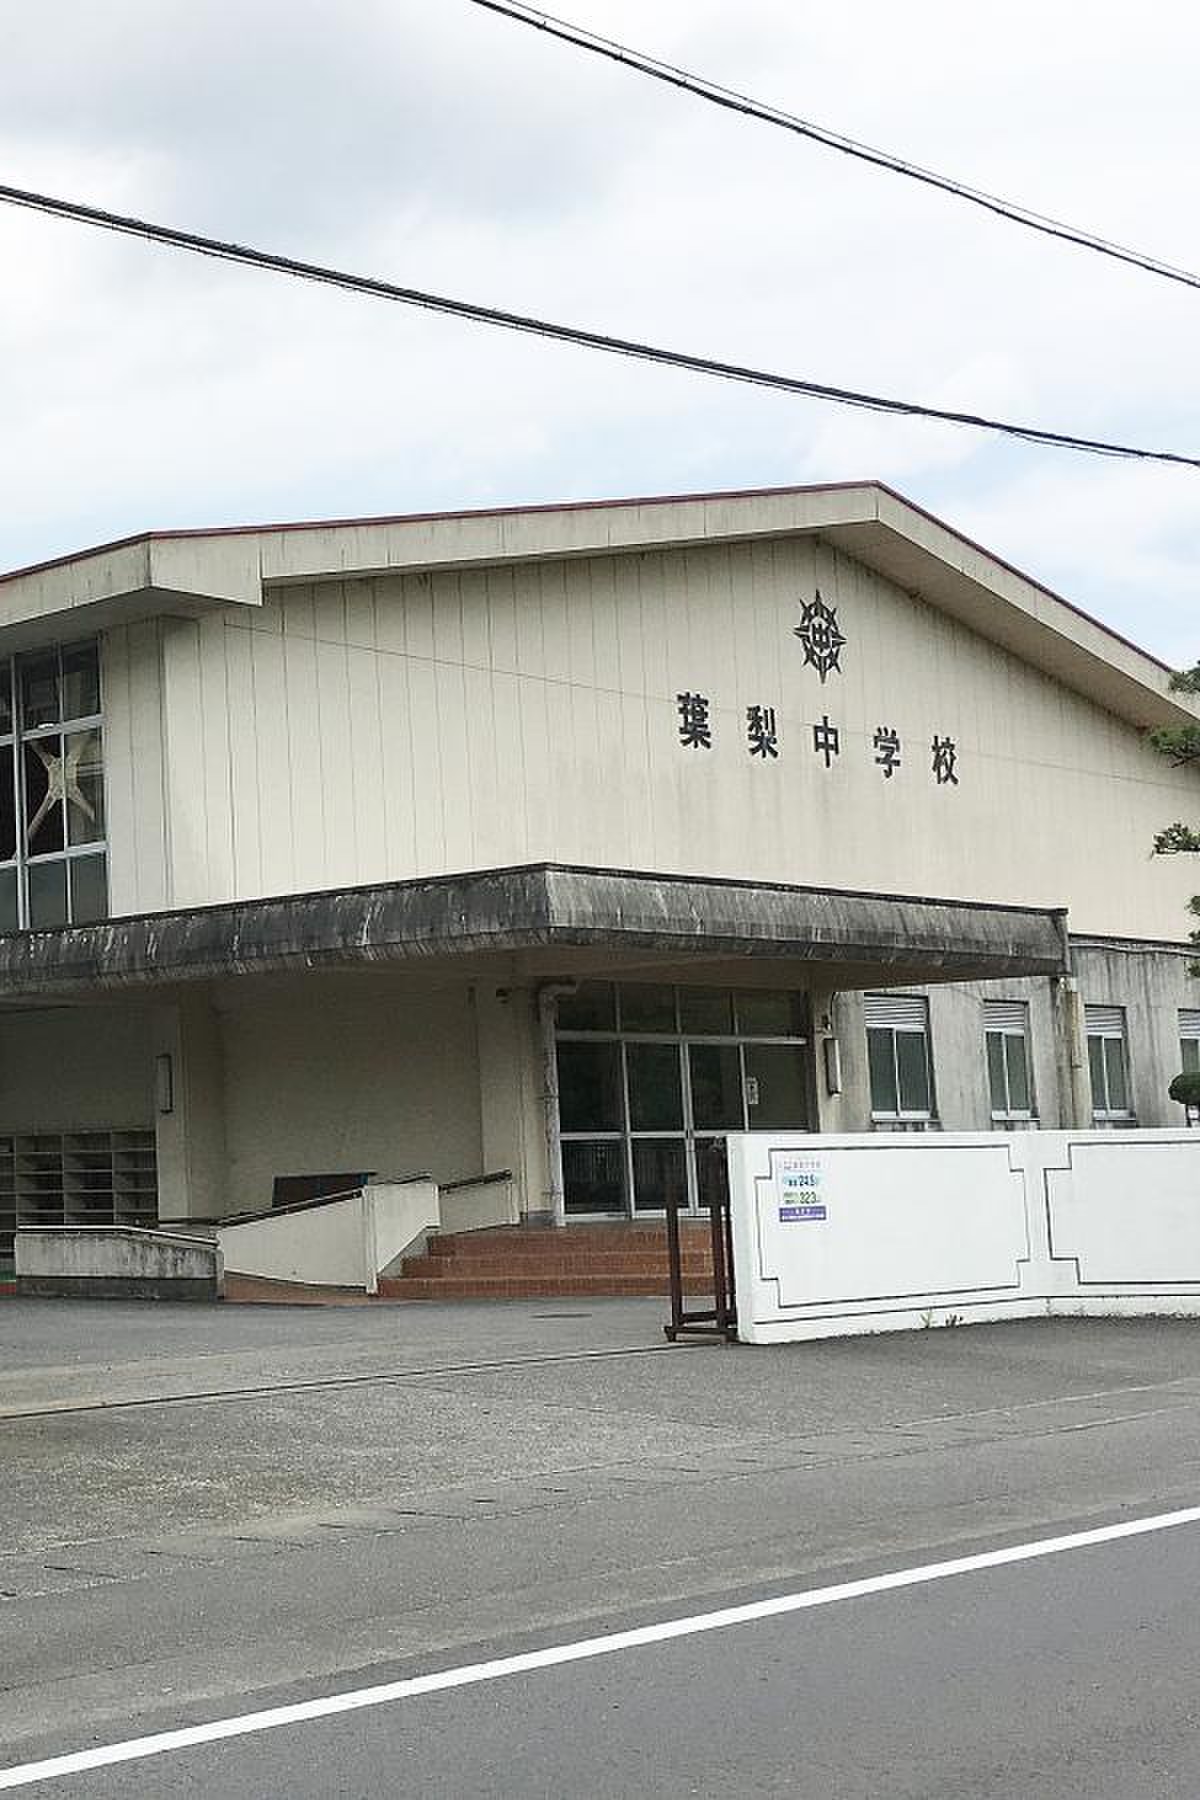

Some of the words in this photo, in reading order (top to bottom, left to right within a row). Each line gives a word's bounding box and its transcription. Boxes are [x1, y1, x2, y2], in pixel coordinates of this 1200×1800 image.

[676, 691, 960, 785] 葉梨中学校
